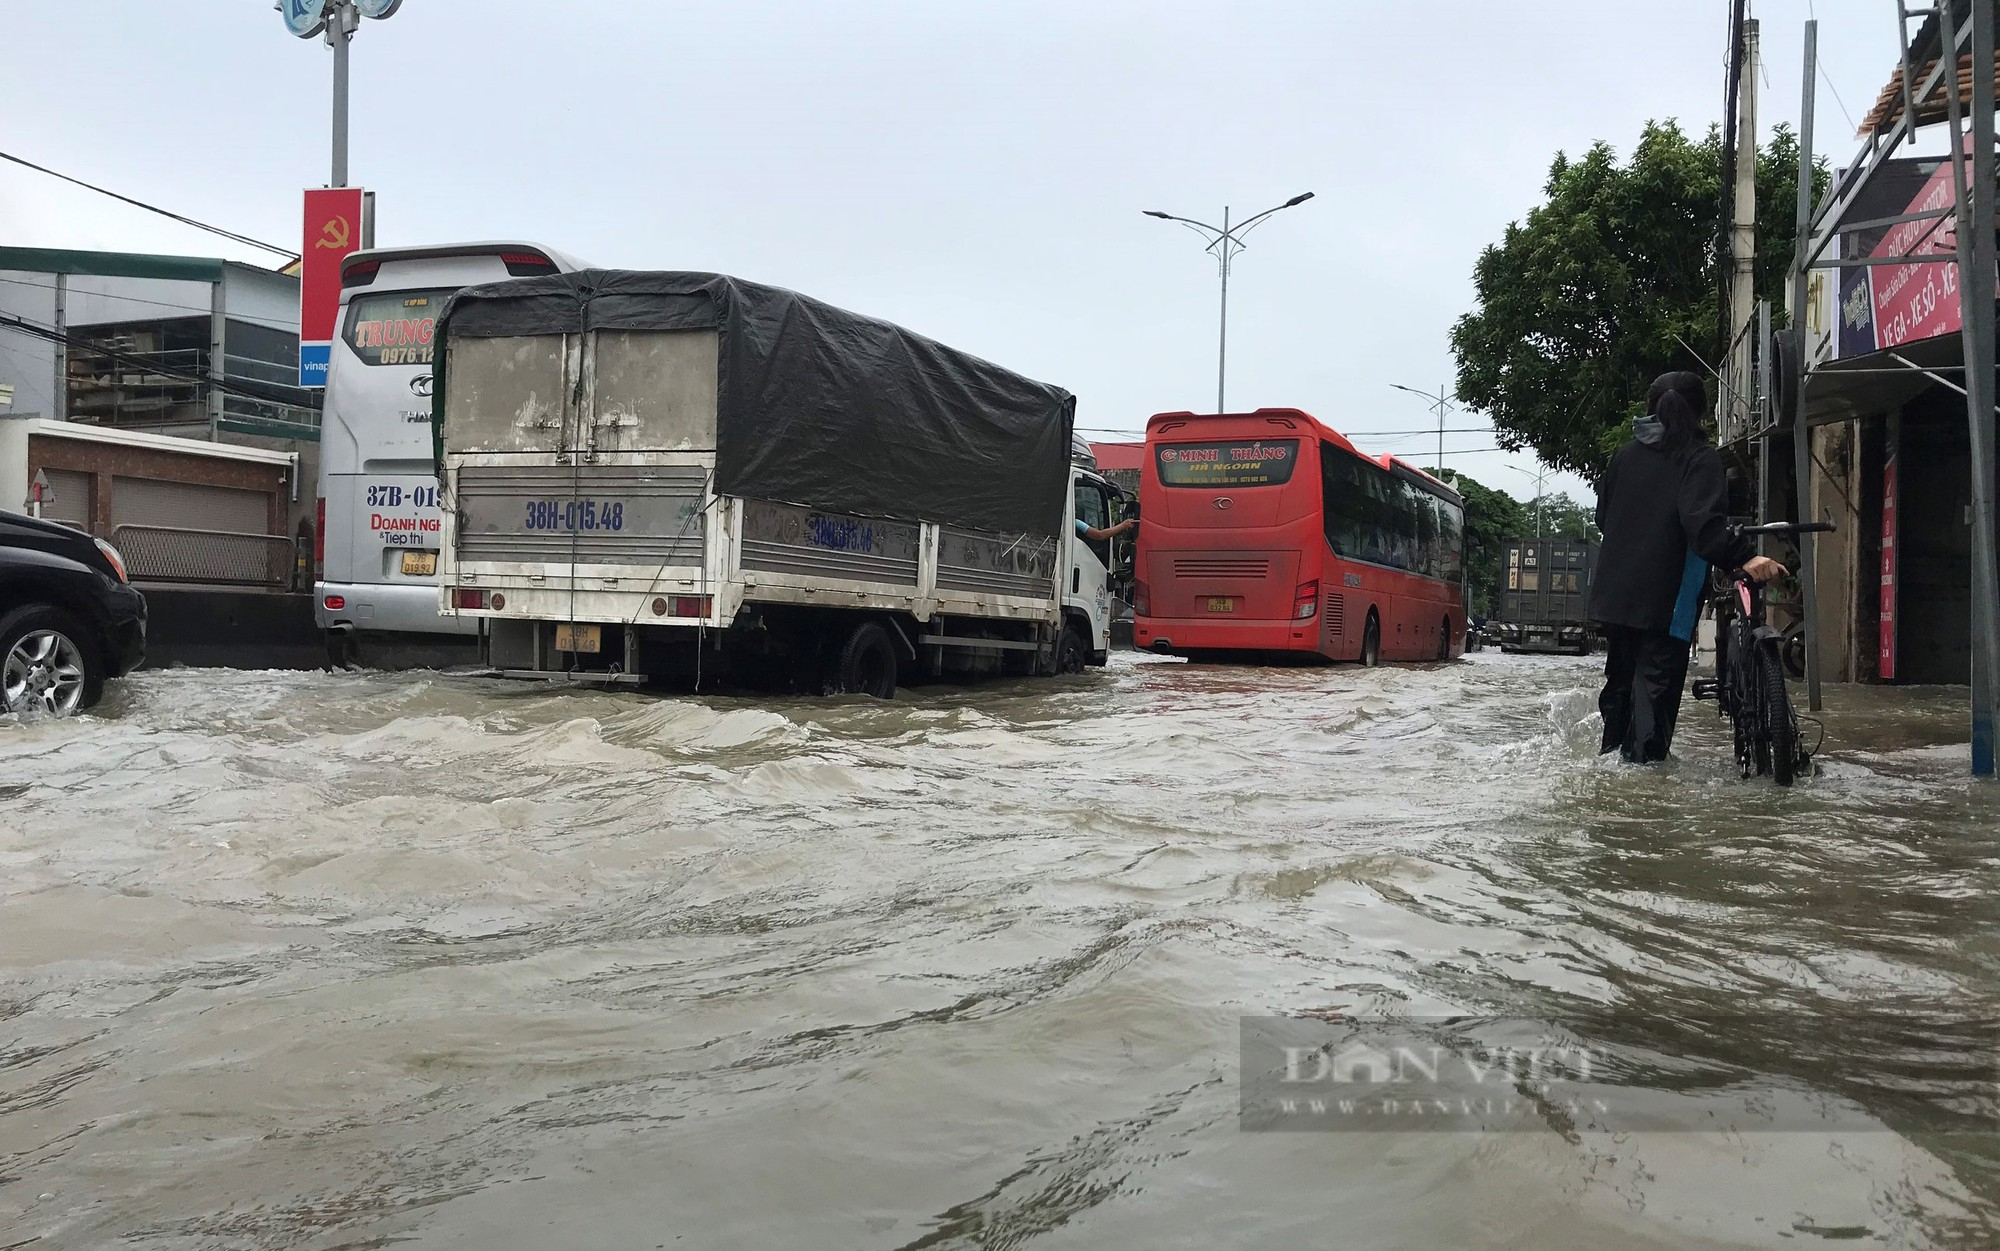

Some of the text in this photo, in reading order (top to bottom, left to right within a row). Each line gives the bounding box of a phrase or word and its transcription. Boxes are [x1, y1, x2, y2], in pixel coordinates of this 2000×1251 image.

[1882, 322, 1895, 348] XE
[1893, 311, 1907, 343] GA
[1909, 293, 1923, 328] XE
[1922, 266, 1936, 317] SỐ
[1941, 261, 1956, 299] XE
[355, 318, 434, 348] TRUNG
[1178, 441, 1287, 462] MINH THẮNG
[371, 514, 416, 531] DOANH
[526, 501, 623, 531] 38H-015.48
